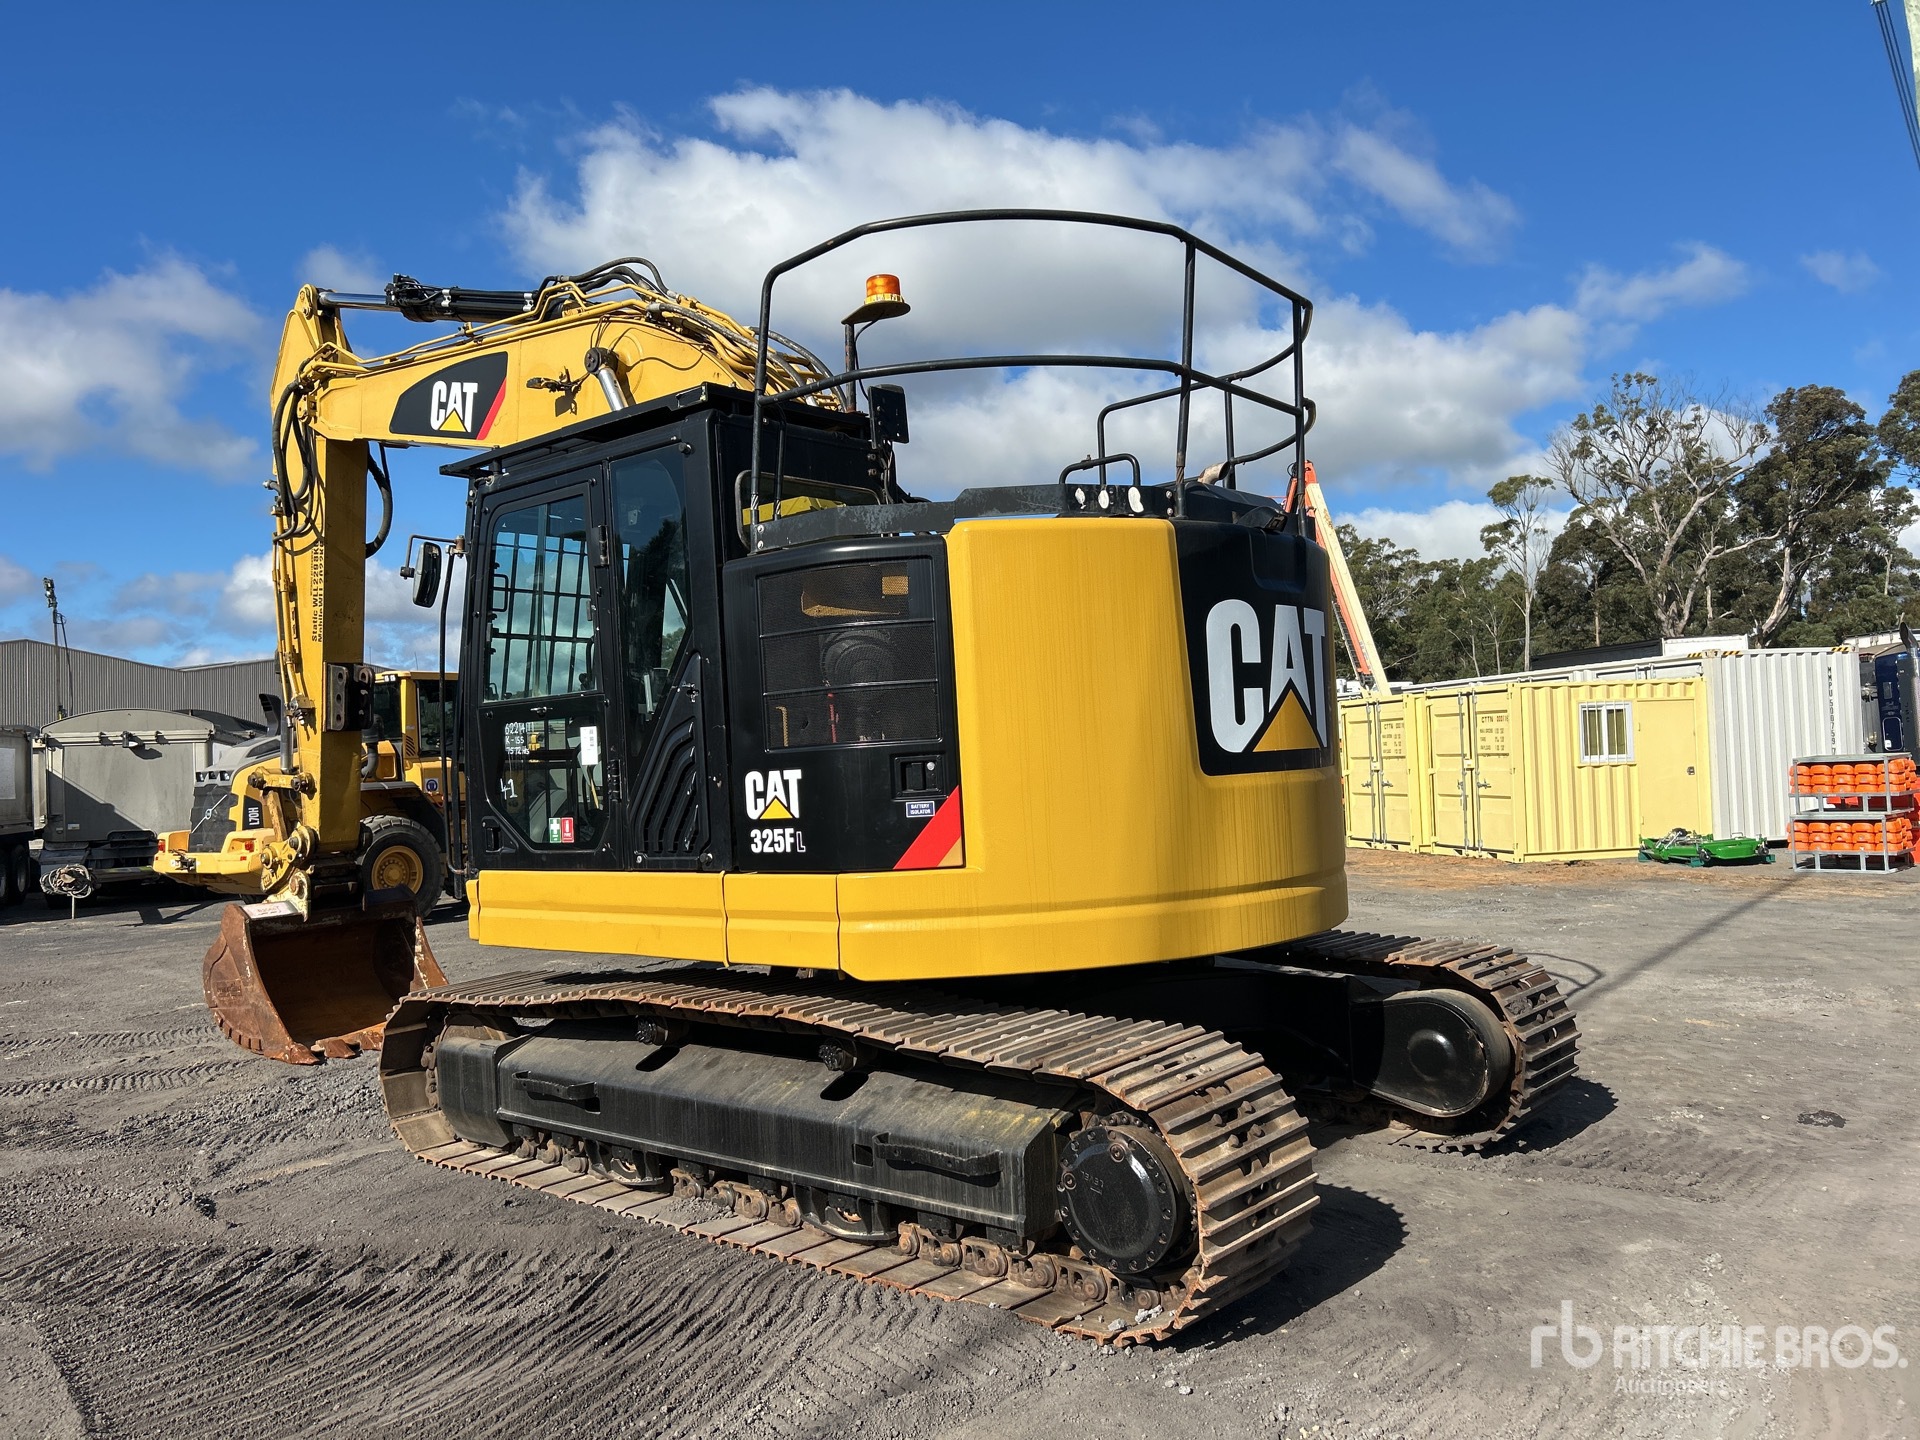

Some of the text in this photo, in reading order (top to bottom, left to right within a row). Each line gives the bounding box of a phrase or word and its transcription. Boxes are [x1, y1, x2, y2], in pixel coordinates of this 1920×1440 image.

[430, 380, 478, 433] CAT
[1206, 599, 1327, 753] CAT
[248, 806, 260, 826] L70H
[745, 768, 802, 820] CAT
